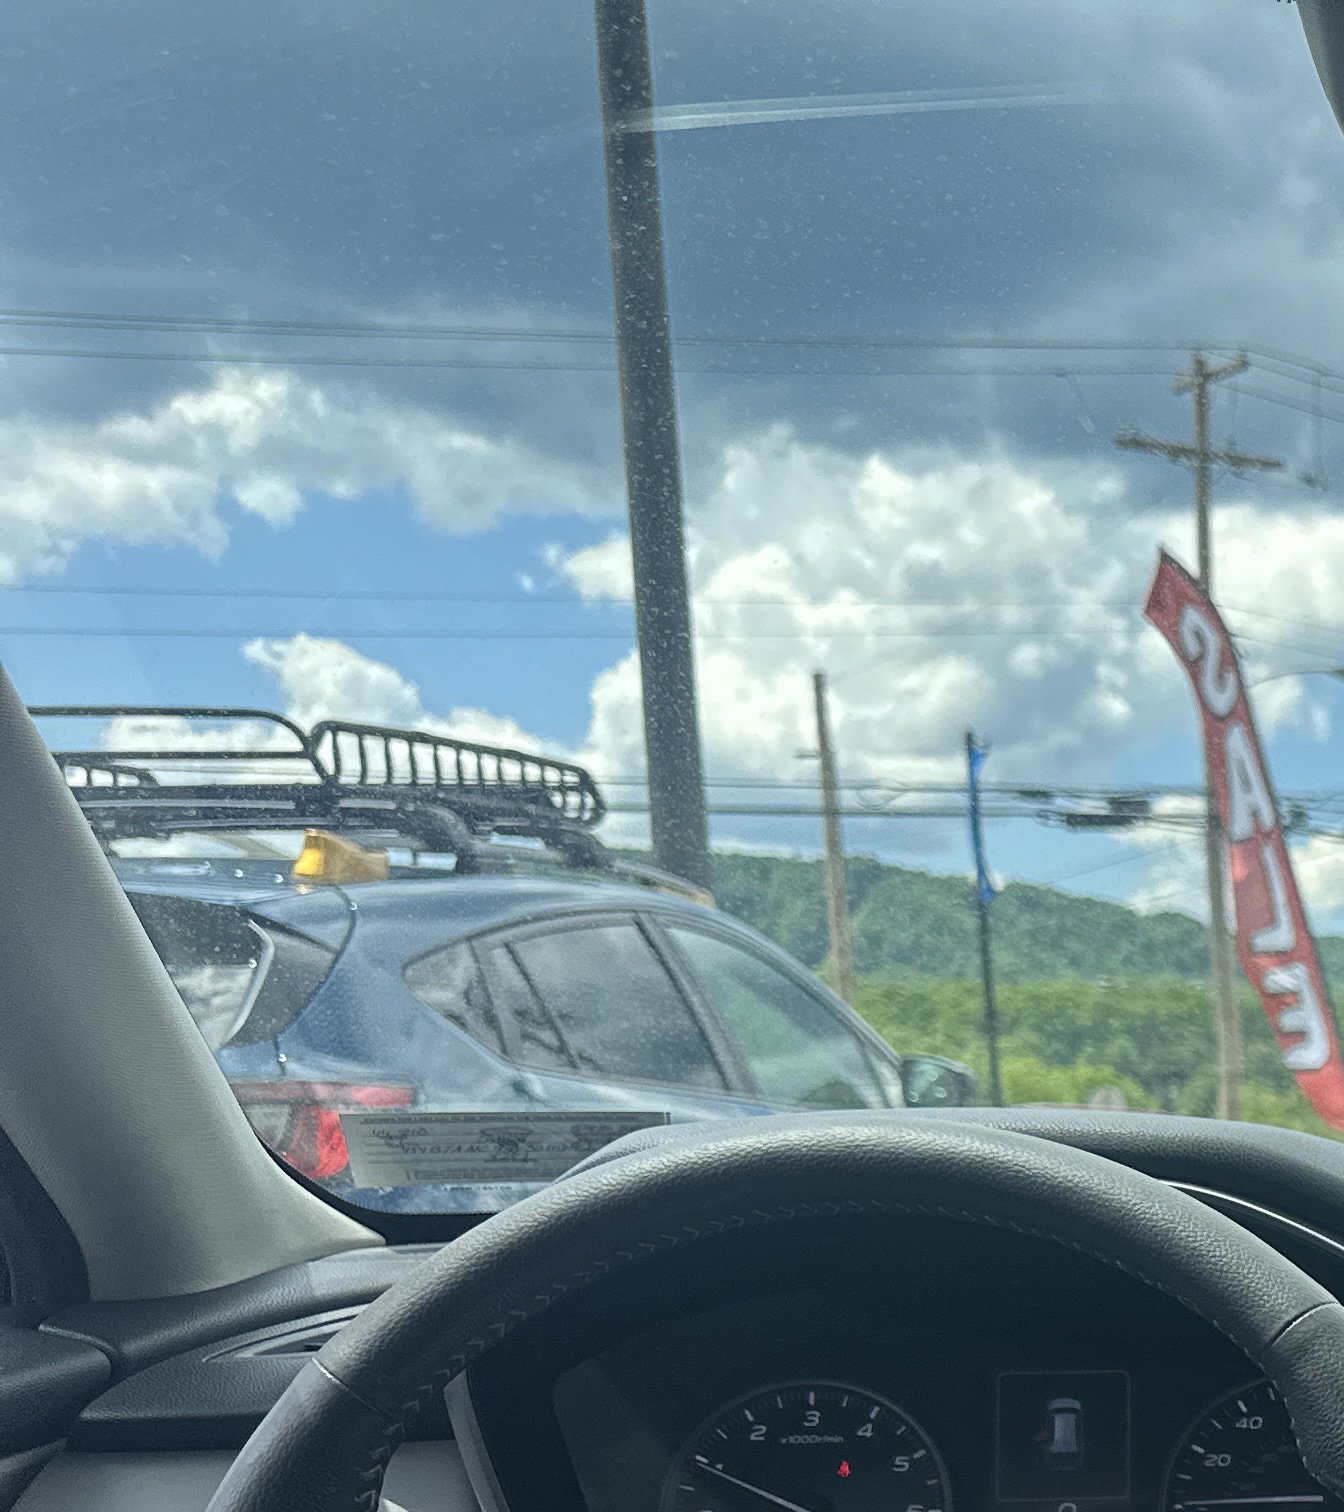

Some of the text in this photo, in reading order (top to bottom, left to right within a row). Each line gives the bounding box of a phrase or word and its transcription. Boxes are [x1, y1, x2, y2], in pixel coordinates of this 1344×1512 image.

[803, 1410, 820, 1426] 3
[1234, 1416, 1263, 1430] 40
[750, 1425, 767, 1440] 2
[856, 1422, 874, 1438] 4
[892, 1455, 910, 1472] 5
[1203, 1453, 1231, 1467] 20
